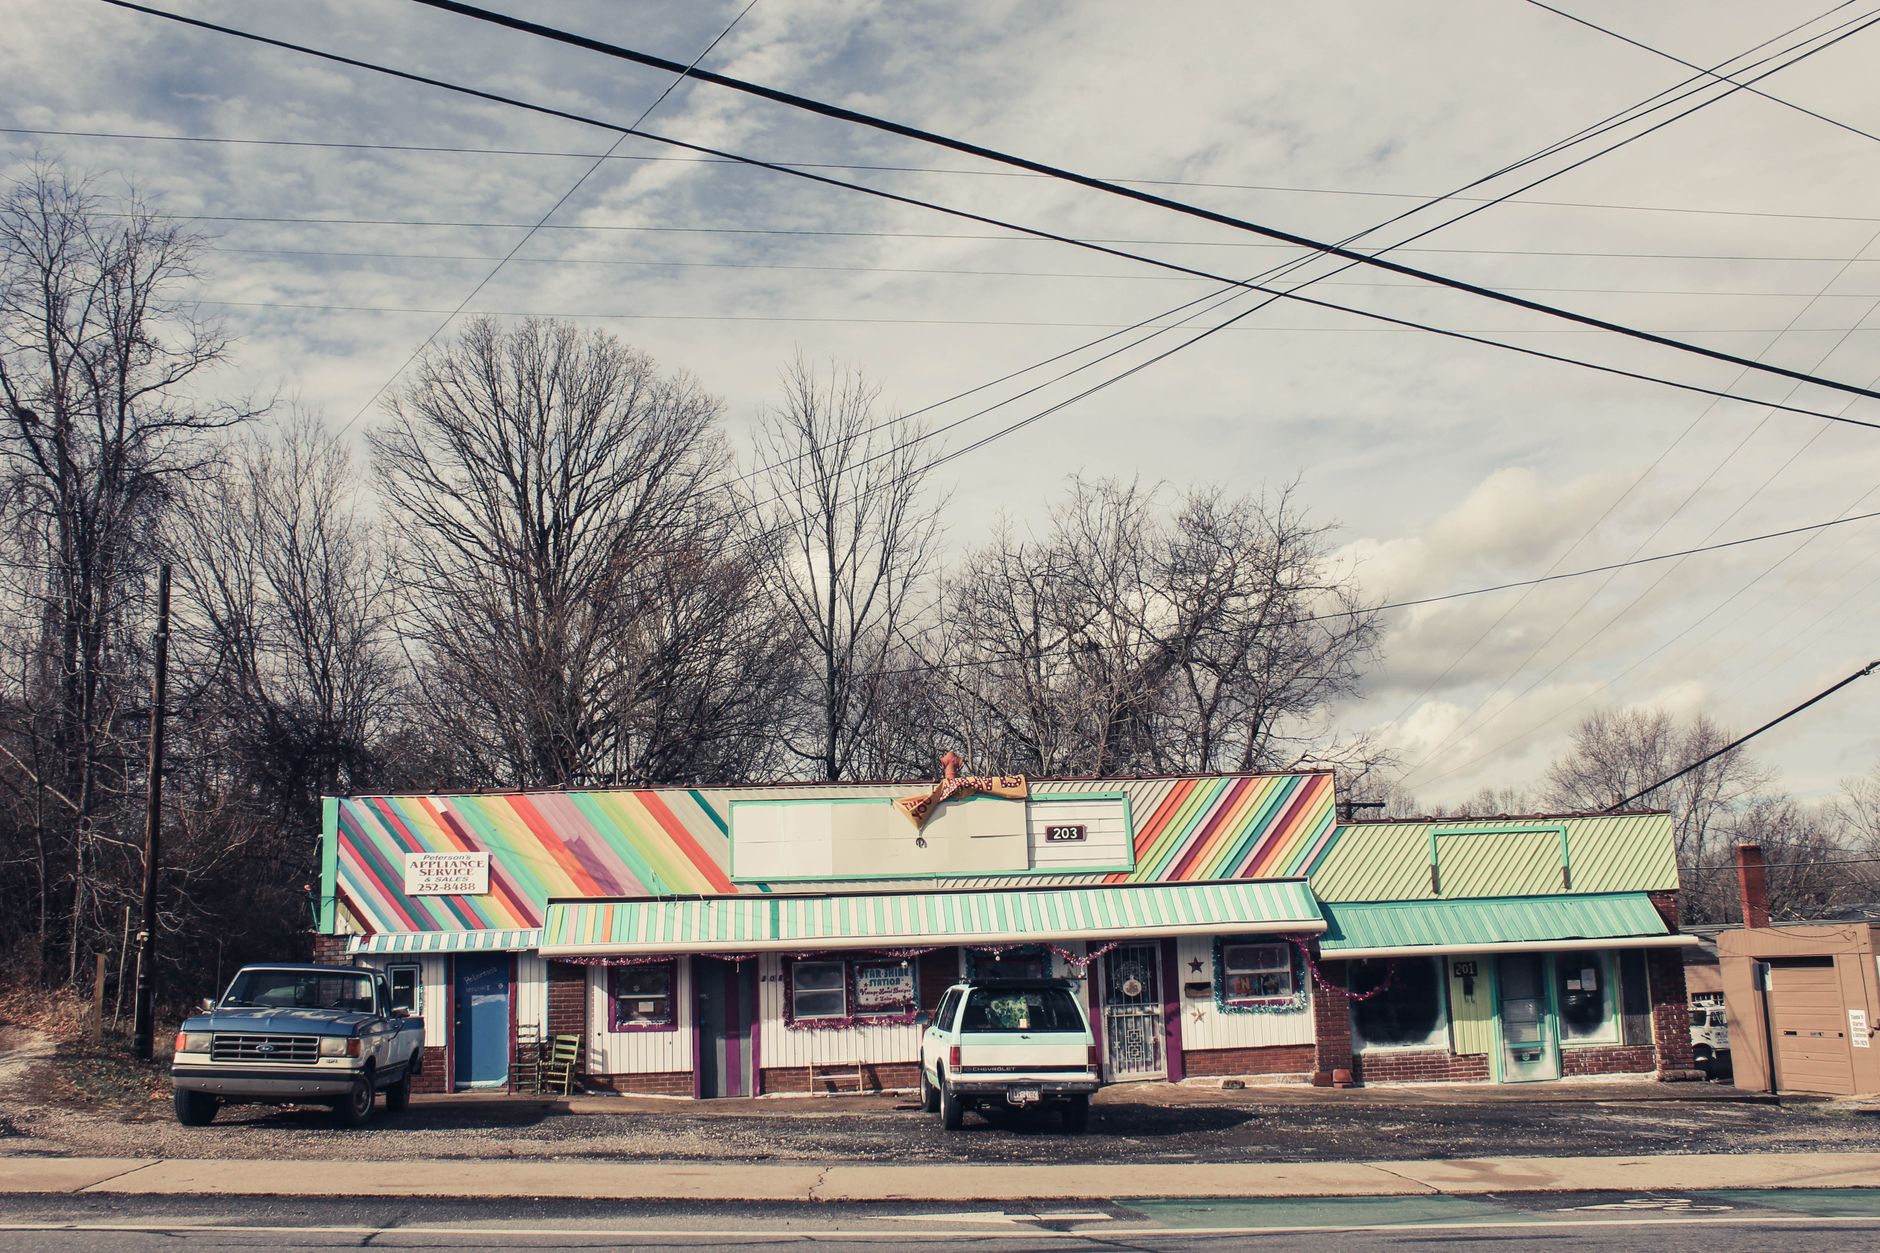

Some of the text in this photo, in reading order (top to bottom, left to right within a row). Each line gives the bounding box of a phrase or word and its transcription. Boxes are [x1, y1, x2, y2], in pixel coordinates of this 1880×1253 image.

[1053, 827, 1078, 840] 203
[410, 860, 485, 869] APPLIANCE
[419, 868, 474, 877] SERVICE
[418, 883, 476, 892] 252-8488
[1455, 962, 1475, 975] 201
[869, 978, 901, 987] STATION
